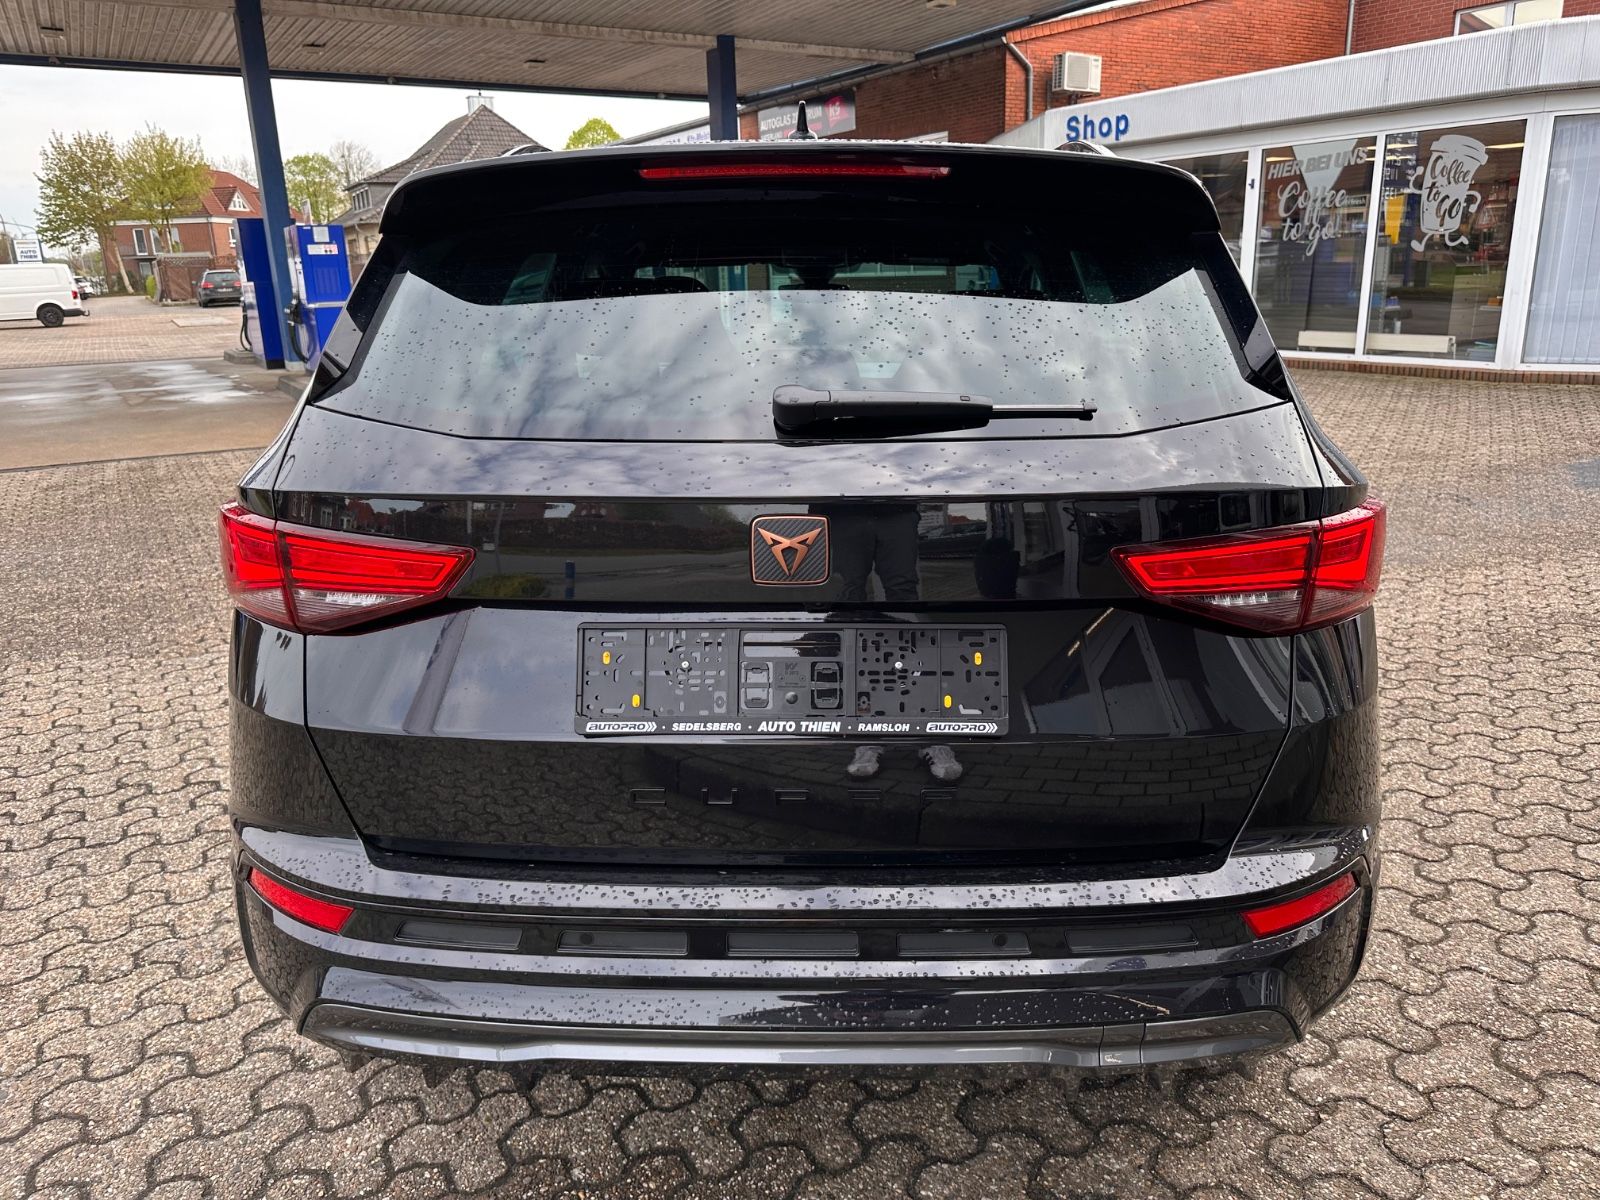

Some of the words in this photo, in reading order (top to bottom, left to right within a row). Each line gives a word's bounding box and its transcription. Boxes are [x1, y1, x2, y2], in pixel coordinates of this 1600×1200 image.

[761, 114, 791, 132] AUTOGLAS
[1066, 114, 1129, 141] Shop
[1268, 161, 1304, 179] HIER
[1305, 154, 1333, 174] BEI
[1333, 147, 1369, 168] UNS
[1431, 154, 1471, 185] Coffee
[1278, 181, 1348, 226] Coffee
[1424, 181, 1442, 203] to
[1281, 217, 1303, 242] to
[1306, 213, 1342, 257] go!
[671, 722, 742, 732] SEDELSBERG
[757, 720, 796, 733] AUTO
[799, 720, 841, 733] THIEN
[858, 722, 910, 732] RAMSLOH
